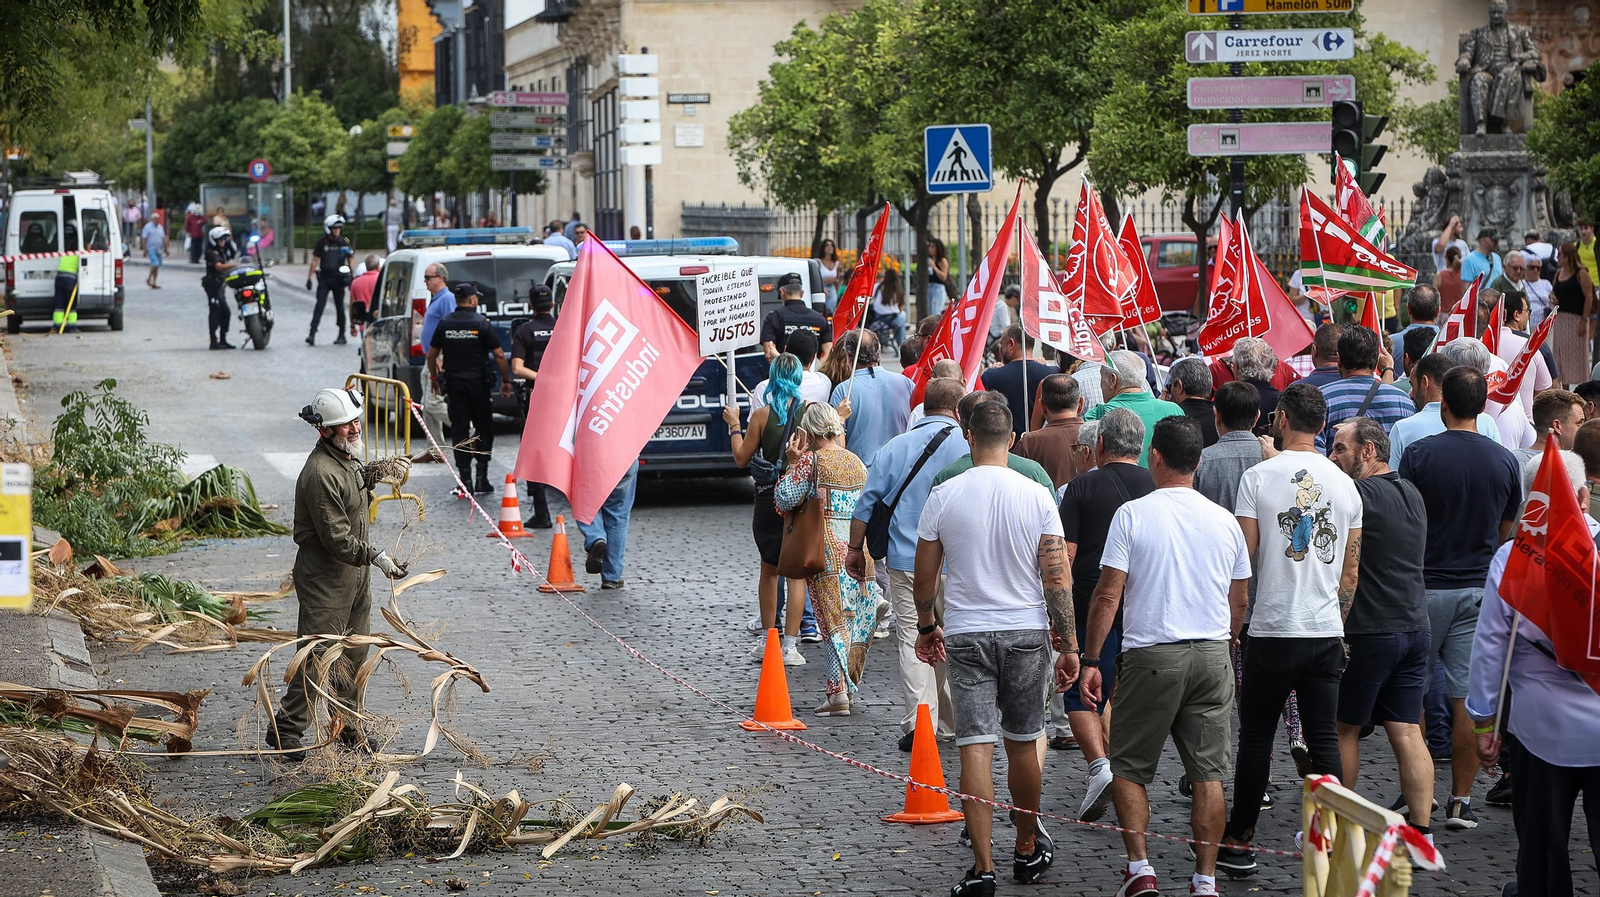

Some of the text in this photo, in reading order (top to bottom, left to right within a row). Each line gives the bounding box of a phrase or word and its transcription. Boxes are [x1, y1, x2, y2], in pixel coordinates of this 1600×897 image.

[1225, 34, 1304, 49] Carrefour
[1264, 49, 1292, 57] NORTE
[1193, 94, 1244, 105] municipal
[1247, 94, 1260, 103] de
[701, 267, 753, 285] INCREIBLE QUE
[726, 279, 751, 291] ESTEMOS
[703, 291, 747, 306] PROTESTANDO
[728, 299, 755, 312] SALARIO
[719, 316, 727, 324] UN
[728, 310, 756, 321] HORARIO
[709, 320, 756, 343] JUSTOS
[652, 425, 704, 438] NP3607AV
[1514, 535, 1573, 590] deración
